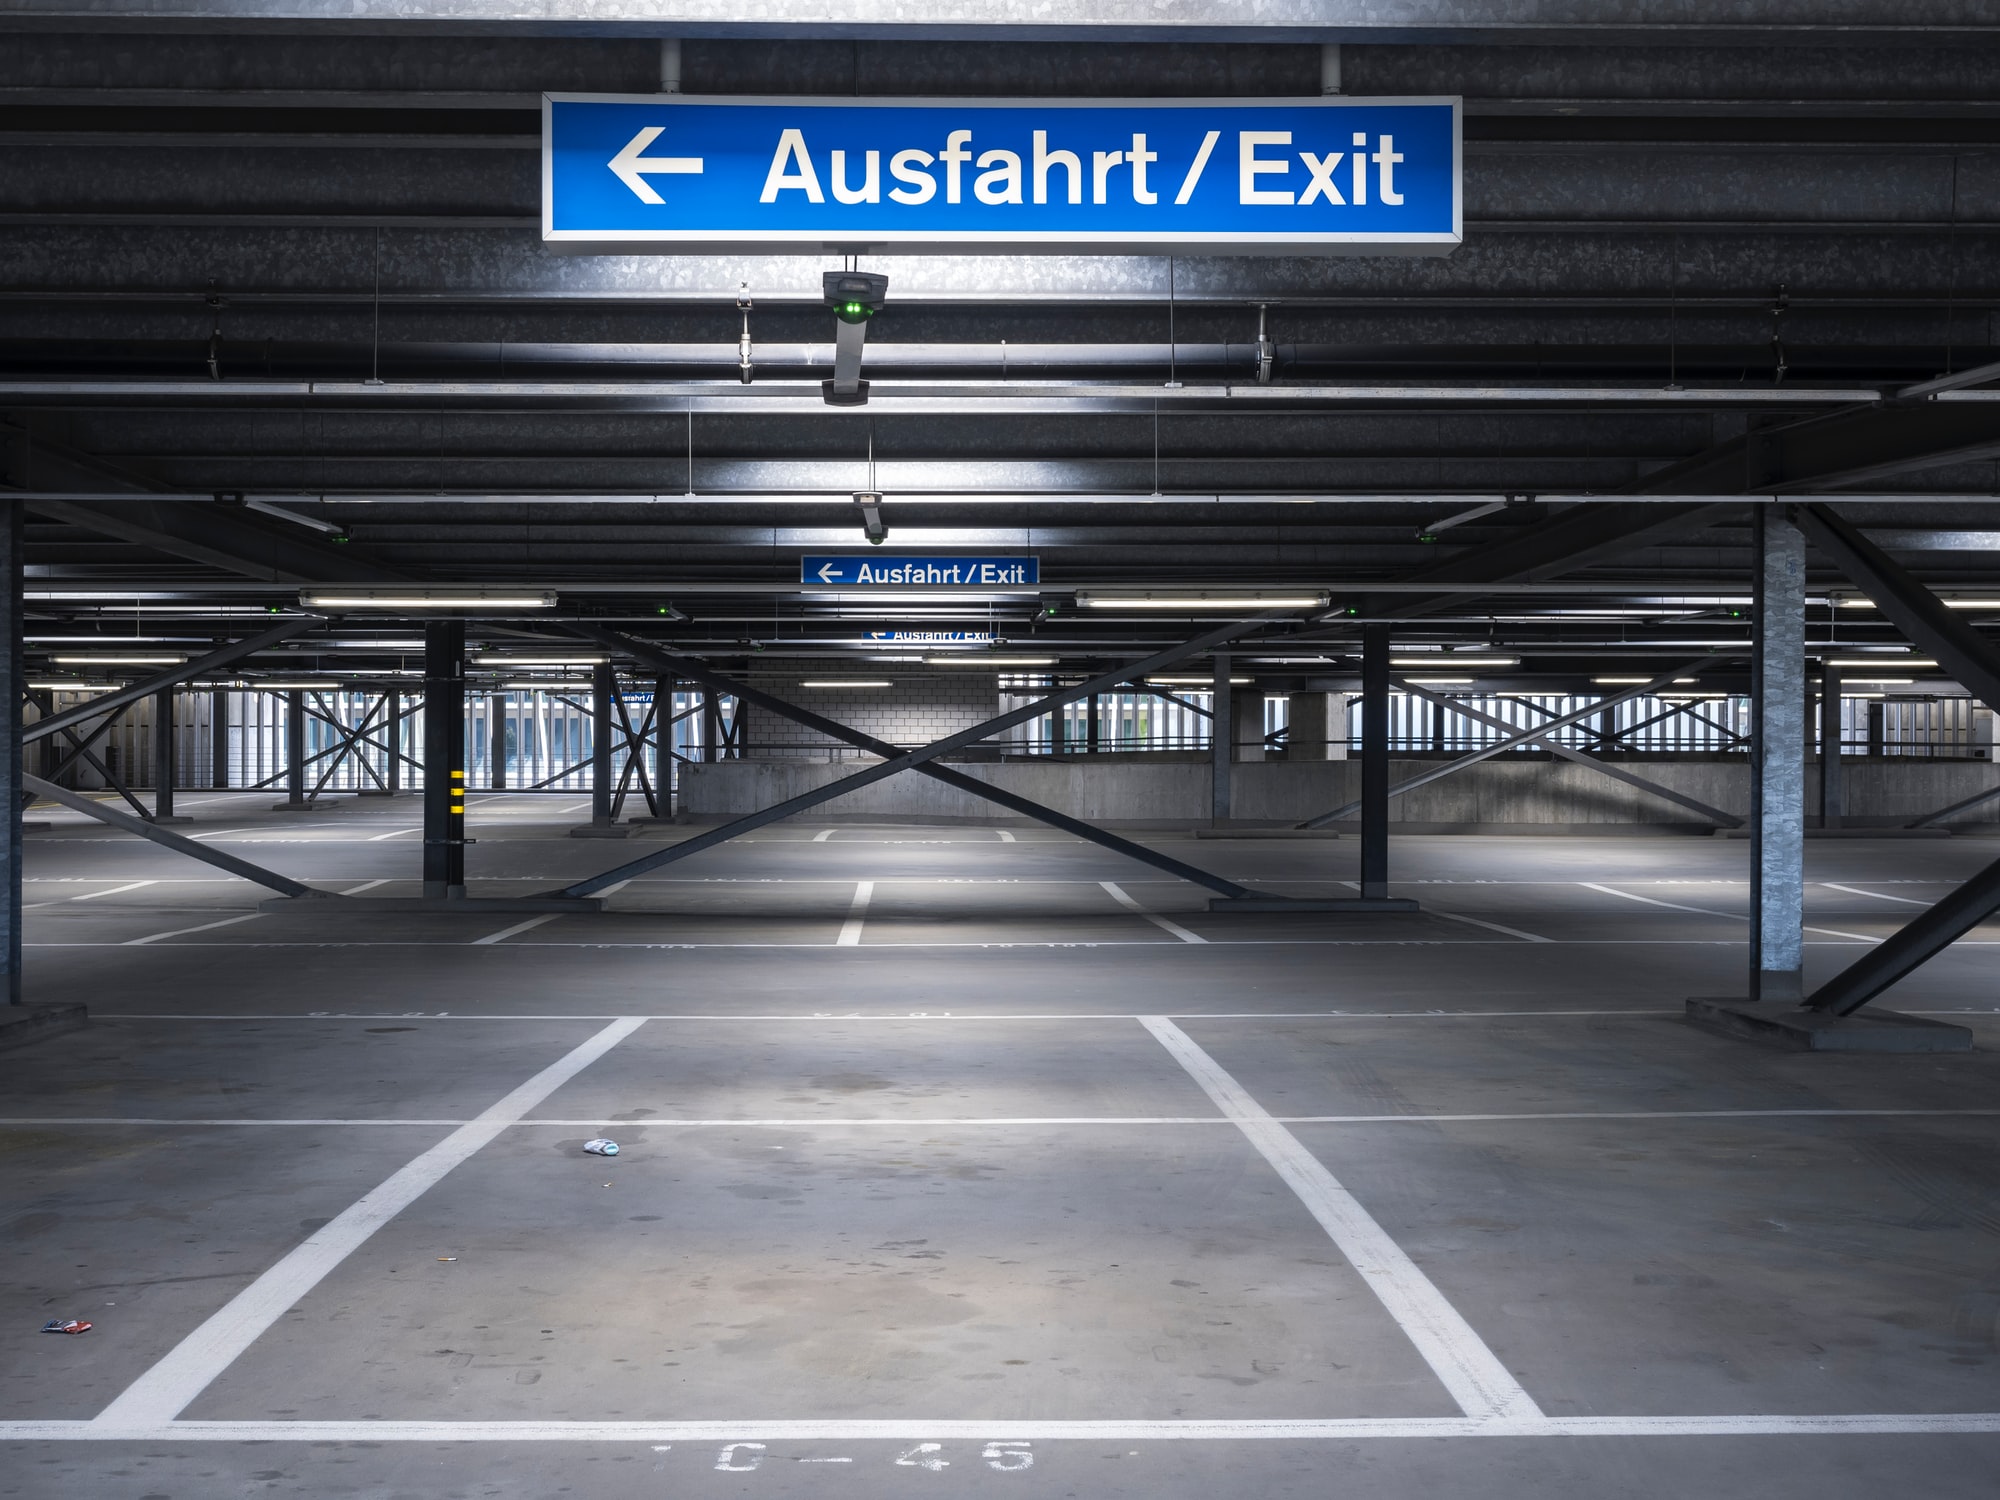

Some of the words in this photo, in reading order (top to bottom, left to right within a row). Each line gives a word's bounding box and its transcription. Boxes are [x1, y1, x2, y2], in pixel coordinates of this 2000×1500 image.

[759, 128, 1157, 205] Ausfahrt
[1238, 131, 1404, 206] Exit
[856, 563, 960, 584] Ausfahrt
[980, 564, 1025, 584] Exit
